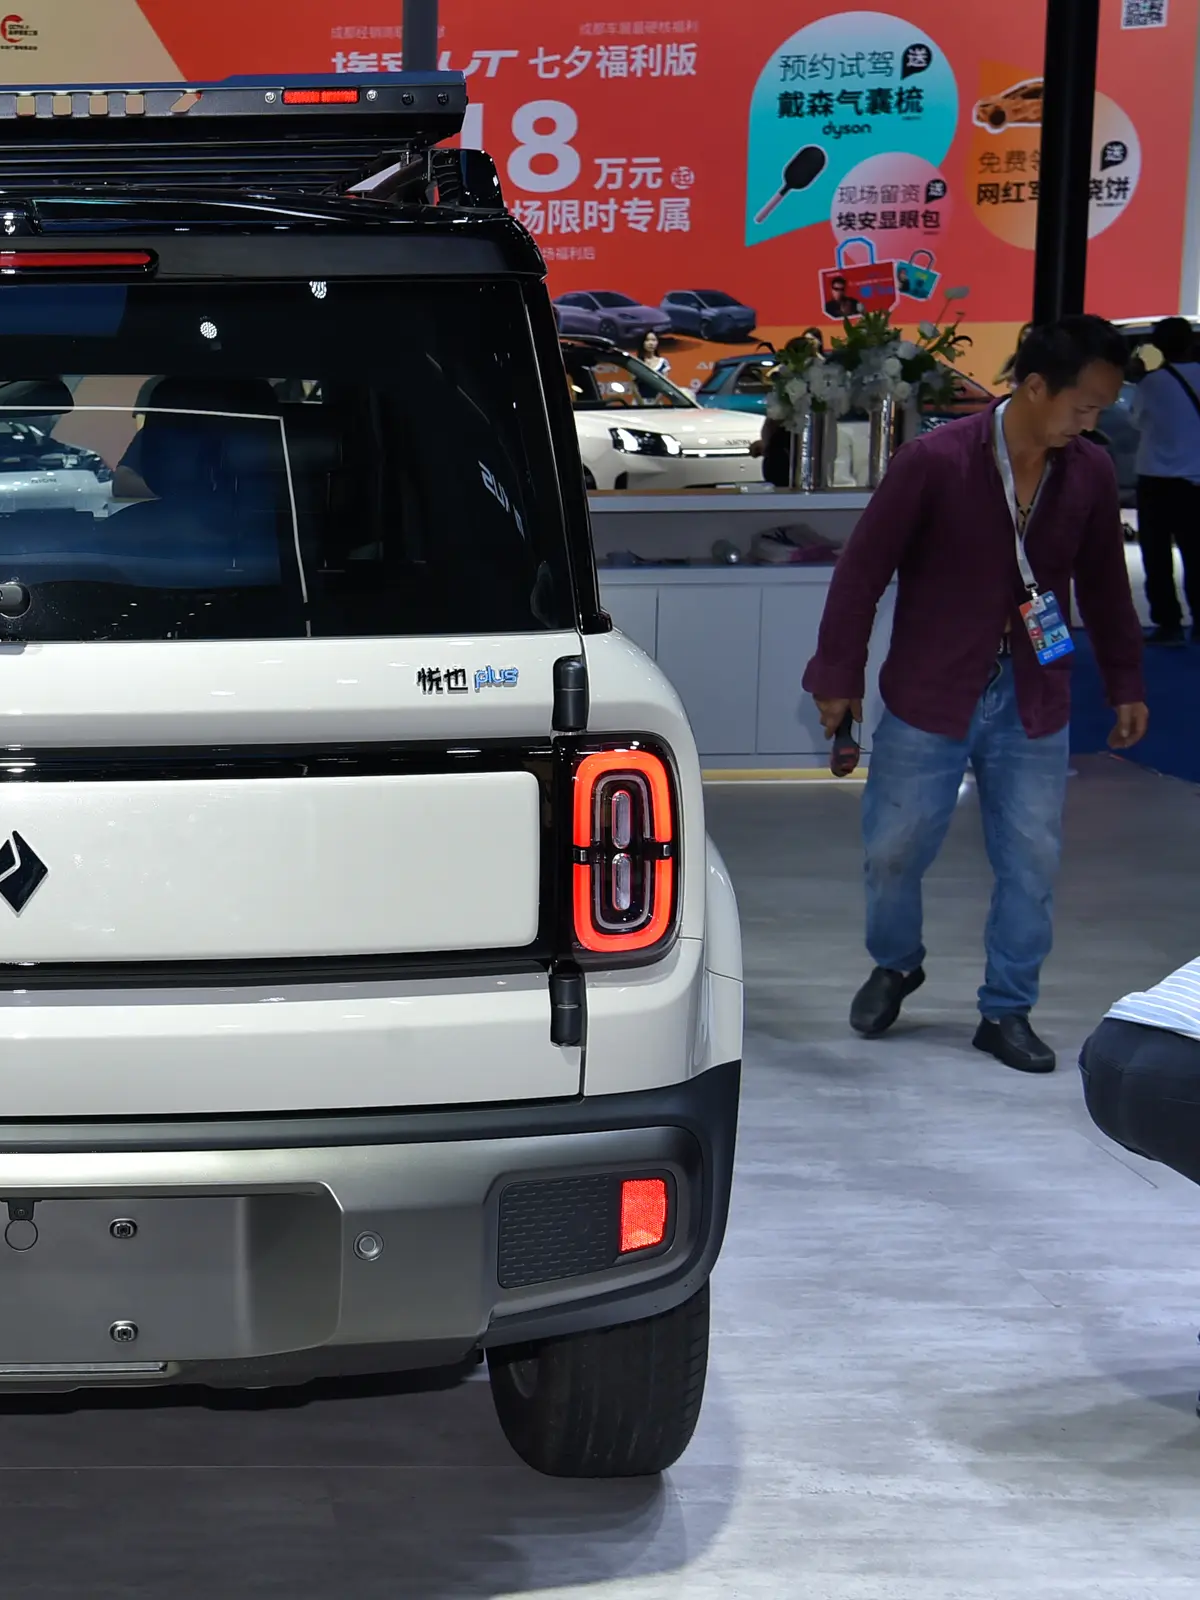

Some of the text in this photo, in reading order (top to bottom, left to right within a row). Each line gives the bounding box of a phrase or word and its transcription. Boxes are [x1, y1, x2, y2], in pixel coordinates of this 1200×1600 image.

[528, 43, 698, 79] 七夕福利版
[779, 47, 928, 82] 预约试驾 送
[778, 86, 924, 119] 戴森气囊梳
[822, 122, 873, 139] dyson
[593, 157, 663, 190] 万元
[838, 184, 920, 204] 现场留资
[503, 197, 691, 235] 场限时专属
[836, 208, 941, 232] 埃安显眼包
[416, 665, 519, 694] 悦也 plus
